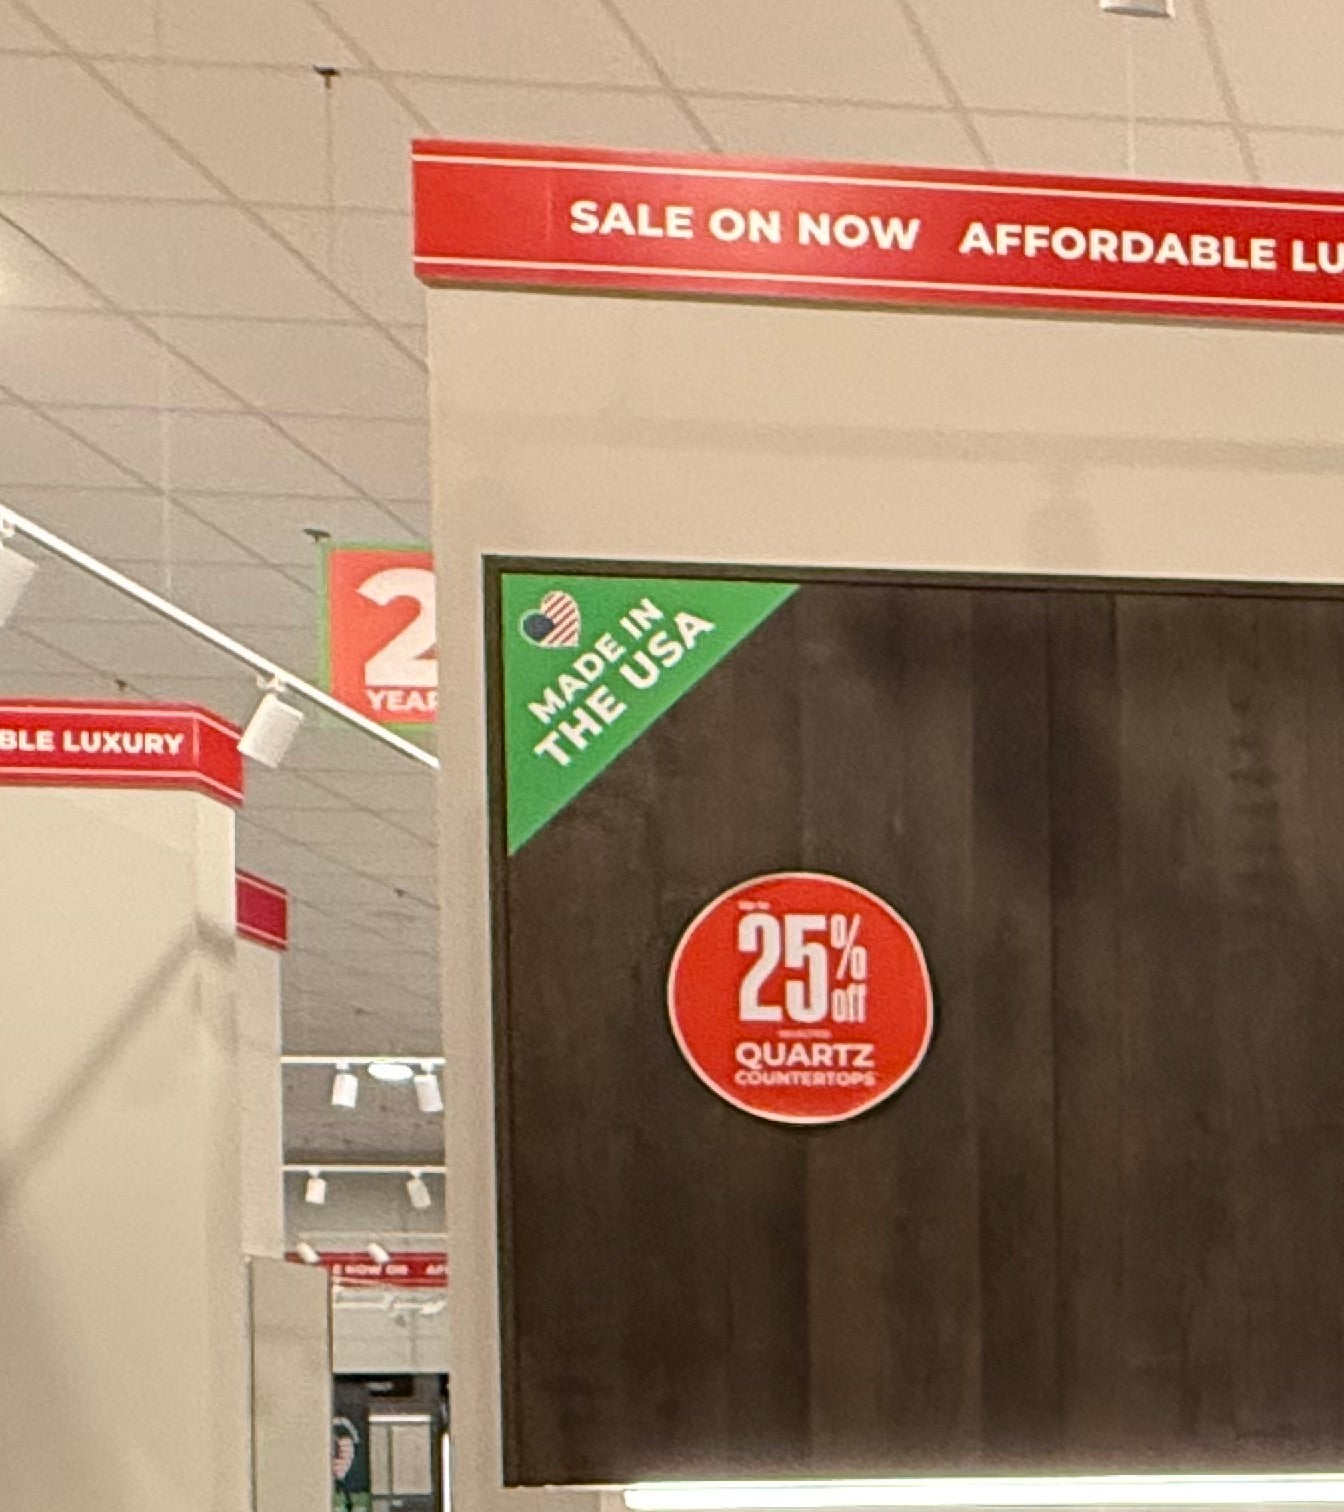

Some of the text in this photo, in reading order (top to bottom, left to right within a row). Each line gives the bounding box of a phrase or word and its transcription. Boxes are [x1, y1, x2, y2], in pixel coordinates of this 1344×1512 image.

[570, 200, 695, 240] SALE
[708, 207, 782, 244] ON
[798, 212, 920, 250] NOW
[958, 222, 1277, 270] AFFORDABLE
[527, 597, 665, 725] MADE IN
[534, 611, 716, 768] THE USA
[62, 730, 184, 755] LUXURY
[831, 983, 868, 1023] off
[735, 1041, 876, 1069] QUARTZ
[735, 1070, 876, 1087] COUNTERTOPS
